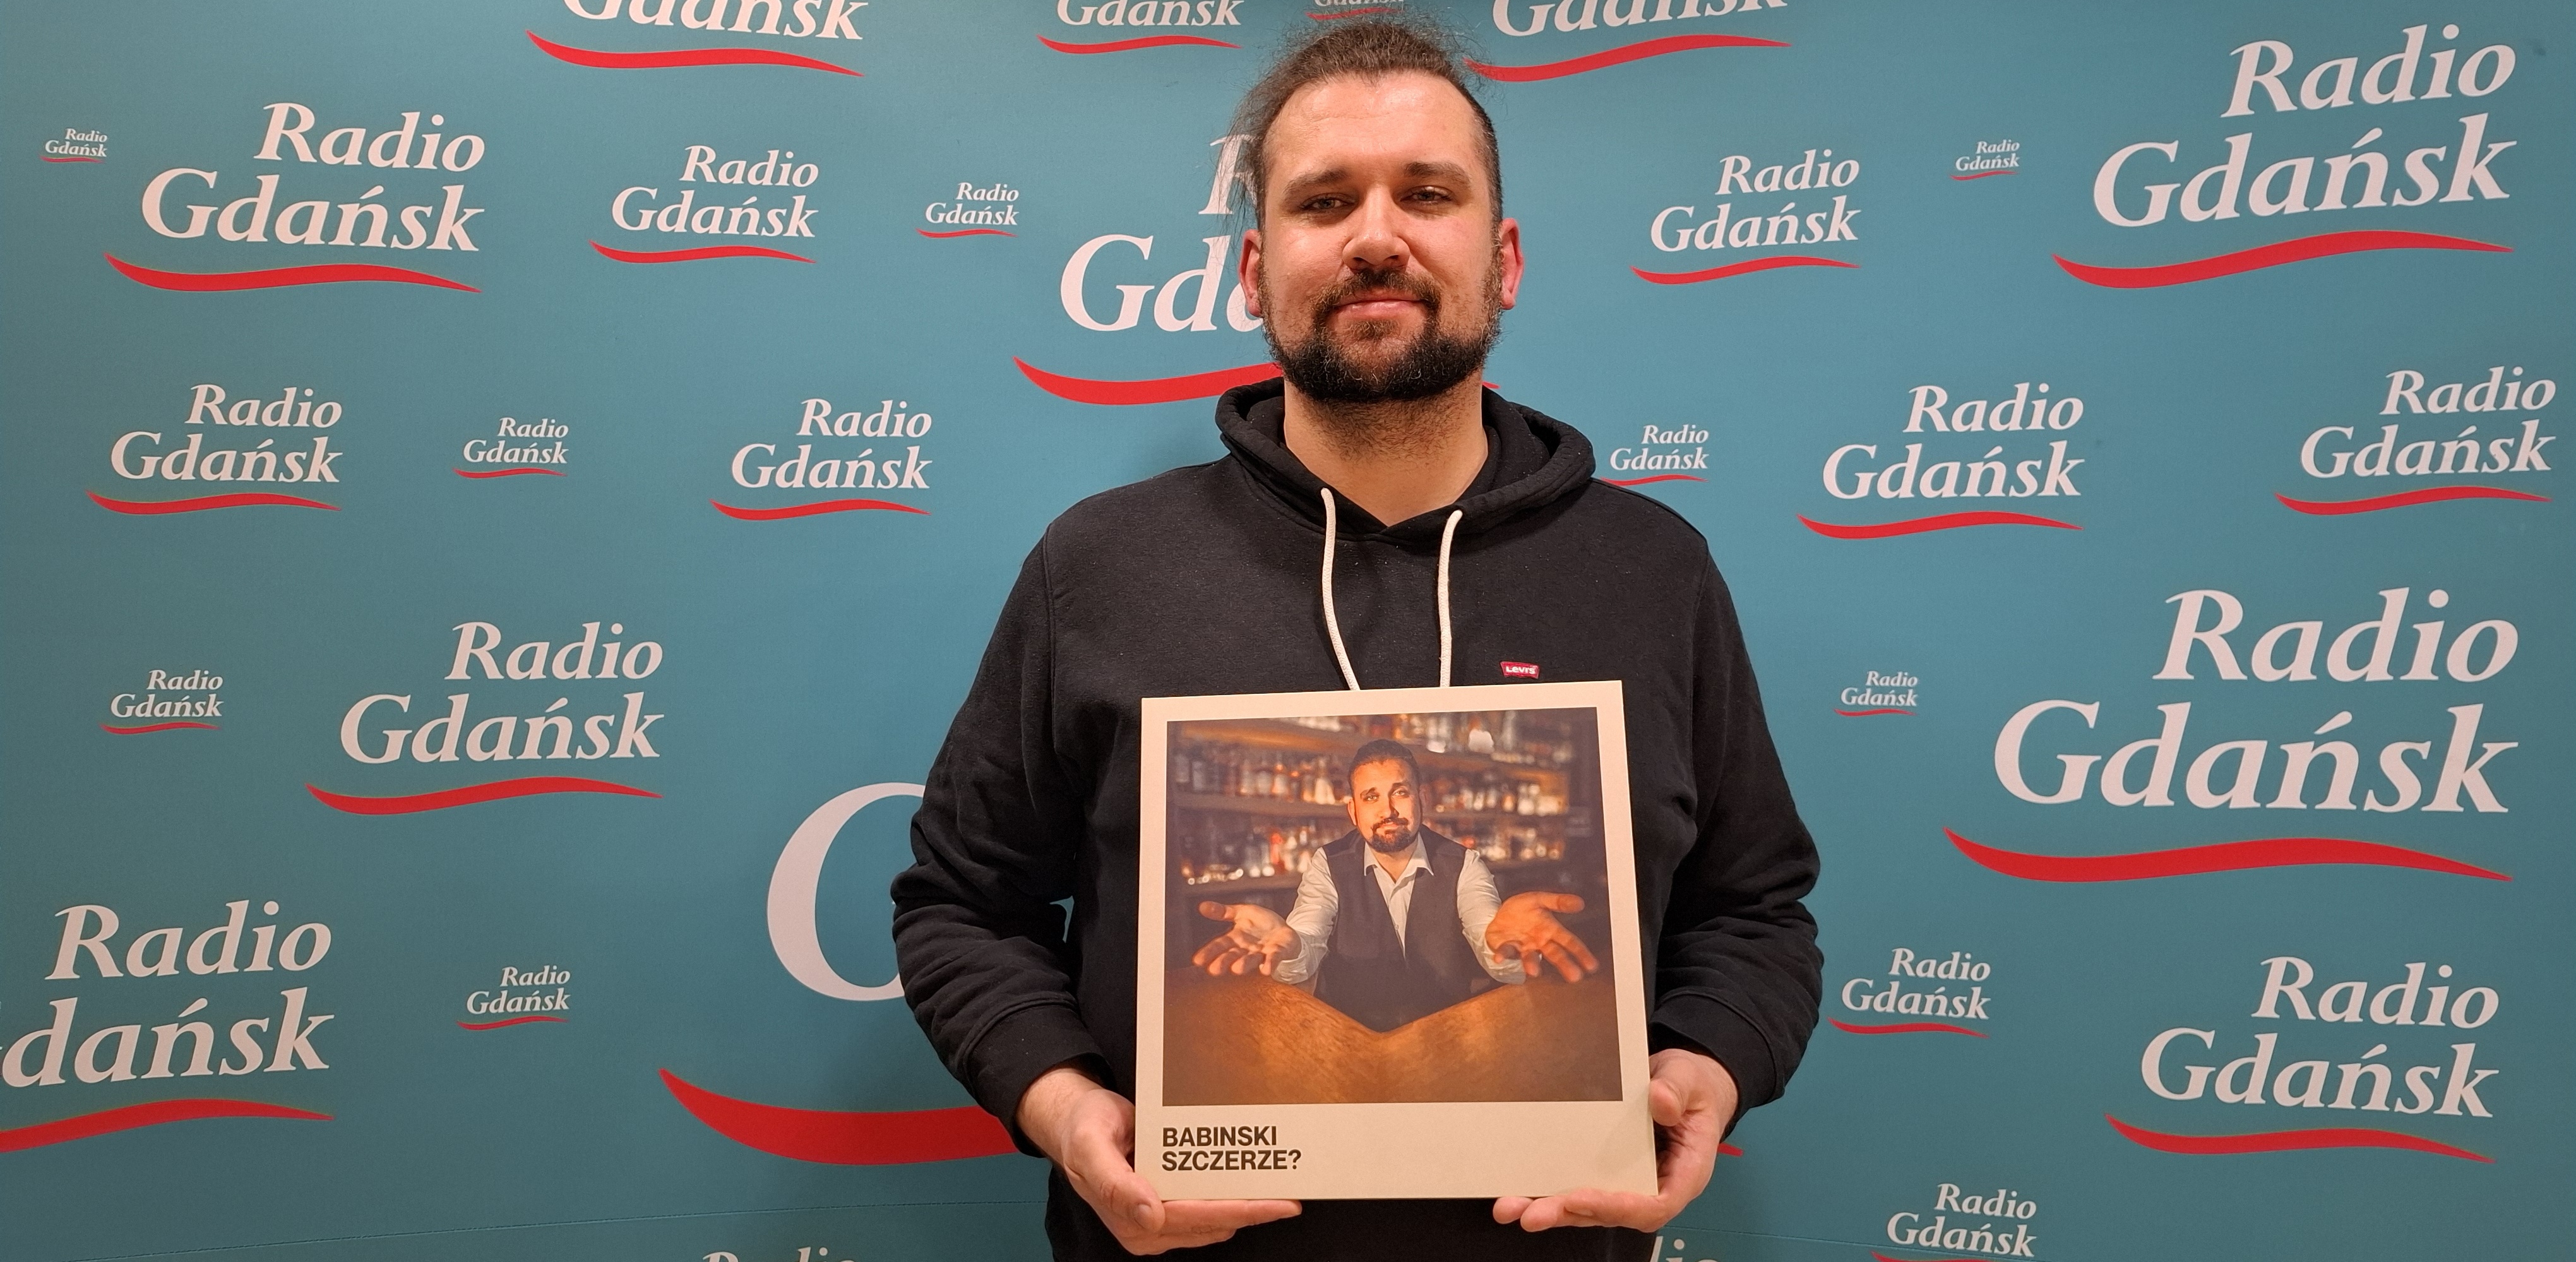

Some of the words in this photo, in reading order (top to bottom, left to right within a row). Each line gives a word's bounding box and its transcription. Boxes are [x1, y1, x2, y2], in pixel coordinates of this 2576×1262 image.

[2221, 25, 2515, 117] Radio
[45, 140, 107, 157] Gdańsk
[66, 129, 107, 142] Radio
[254, 103, 484, 171] Radio
[1976, 140, 2019, 153] Radio
[679, 146, 818, 187] Radio
[1715, 150, 1859, 194] Radio
[1956, 153, 2018, 171] Gdańsk
[2094, 113, 2516, 227] Gdańsk
[142, 169, 484, 251] Gdańsk
[612, 187, 818, 237] Gdańsk
[957, 182, 1018, 201] Radio
[926, 203, 1018, 225] Gdańsk
[1651, 195, 1861, 251] Gdańsk
[185, 384, 342, 427] Radio
[1903, 383, 2083, 432] Radio
[2380, 366, 2555, 414] Radio
[498, 417, 568, 438] Radio
[797, 399, 931, 437] Radio
[1642, 424, 1709, 444] Radio
[112, 432, 342, 482] Gdańsk
[464, 440, 568, 463] Gdańsk
[732, 444, 932, 489] Gdańsk
[1610, 447, 1709, 470] Gdańsk
[2301, 419, 2555, 478] Gdańsk
[1823, 441, 2084, 499] Gdańsk
[444, 622, 662, 679] Radio
[2153, 588, 2517, 682] Radio
[147, 670, 223, 689] Radio
[1841, 688, 1916, 706] Gdańsk
[1866, 671, 1917, 687] Radio
[111, 694, 223, 717] Gdańsk
[341, 692, 664, 763] Gdańsk
[1995, 700, 2518, 812] Gdańsk
[45, 900, 331, 979] Radio
[501, 965, 570, 986] Radio
[1889, 948, 1990, 981] Radio
[467, 988, 569, 1014] Gdańsk
[1842, 979, 1990, 1019] Gdańsk
[2251, 957, 2498, 1028] Radio
[0, 987, 334, 1087] dańsk
[2142, 1028, 2499, 1117] Gdańsk
[1163, 1126, 1276, 1146] BABINSKI
[1162, 1150, 1301, 1171] SZCZERZE?
[1935, 1184, 2036, 1218] Radio
[1888, 1213, 2036, 1256] Gdańsk
